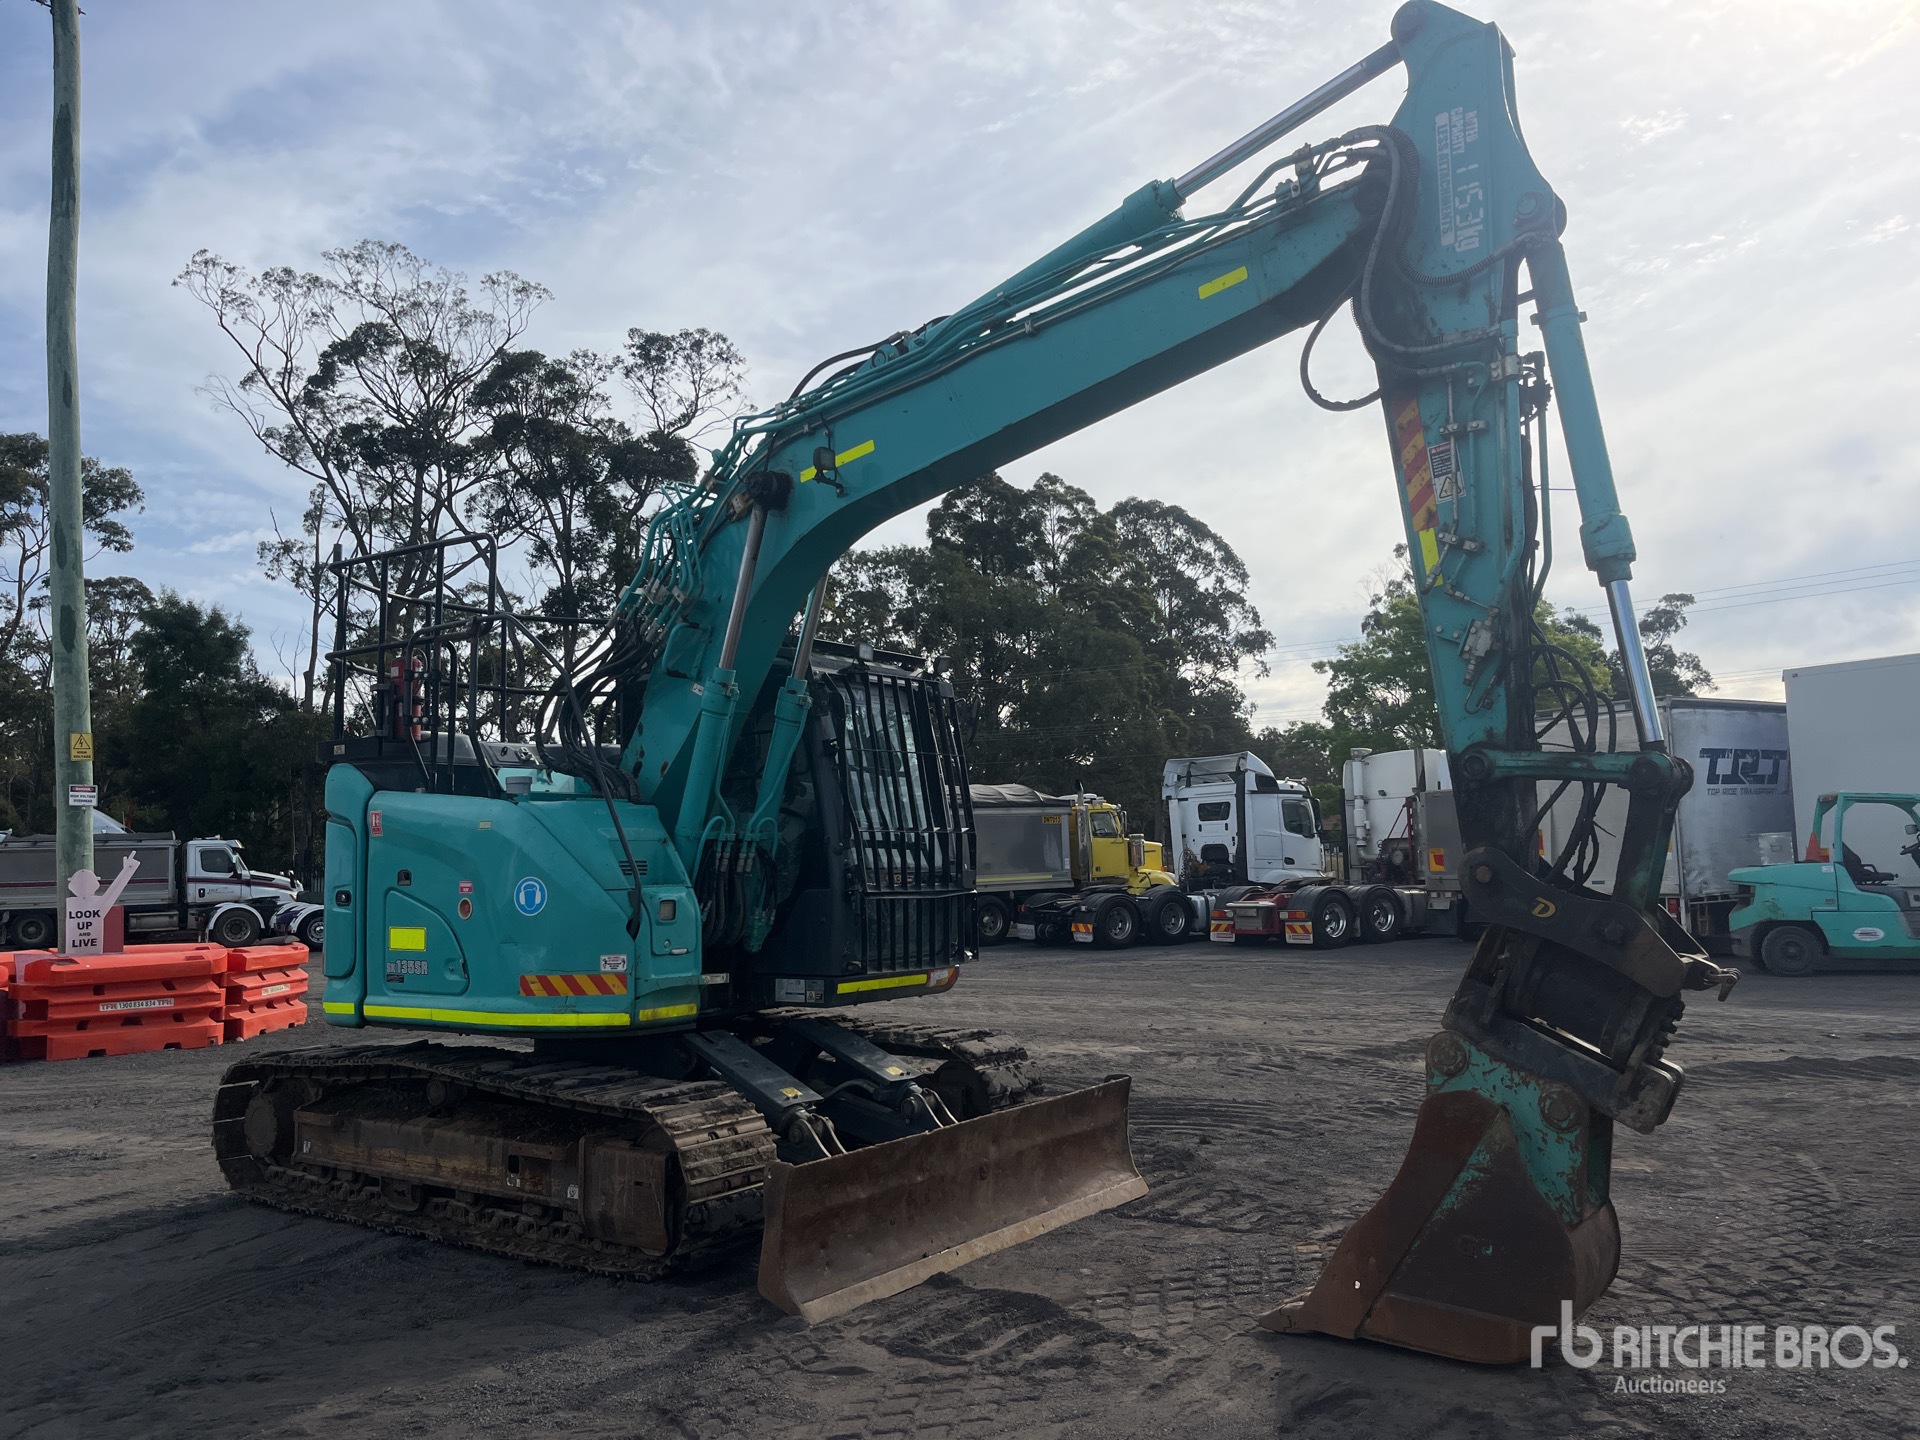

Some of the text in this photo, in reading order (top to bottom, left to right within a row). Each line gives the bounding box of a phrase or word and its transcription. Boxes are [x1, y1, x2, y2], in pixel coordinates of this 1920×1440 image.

[1450, 106, 1465, 155] CAPACITY
[1465, 110, 1479, 142] RATED
[1437, 123, 1453, 235] LESS ATTACHMENTS
[1698, 748, 1788, 785] TRT
[1707, 788, 1720, 796] TOP
[1722, 788, 1738, 796] RIDE
[68, 910, 101, 919] LOOK
[77, 921, 93, 930] UP
[72, 938, 98, 948] LIVE
